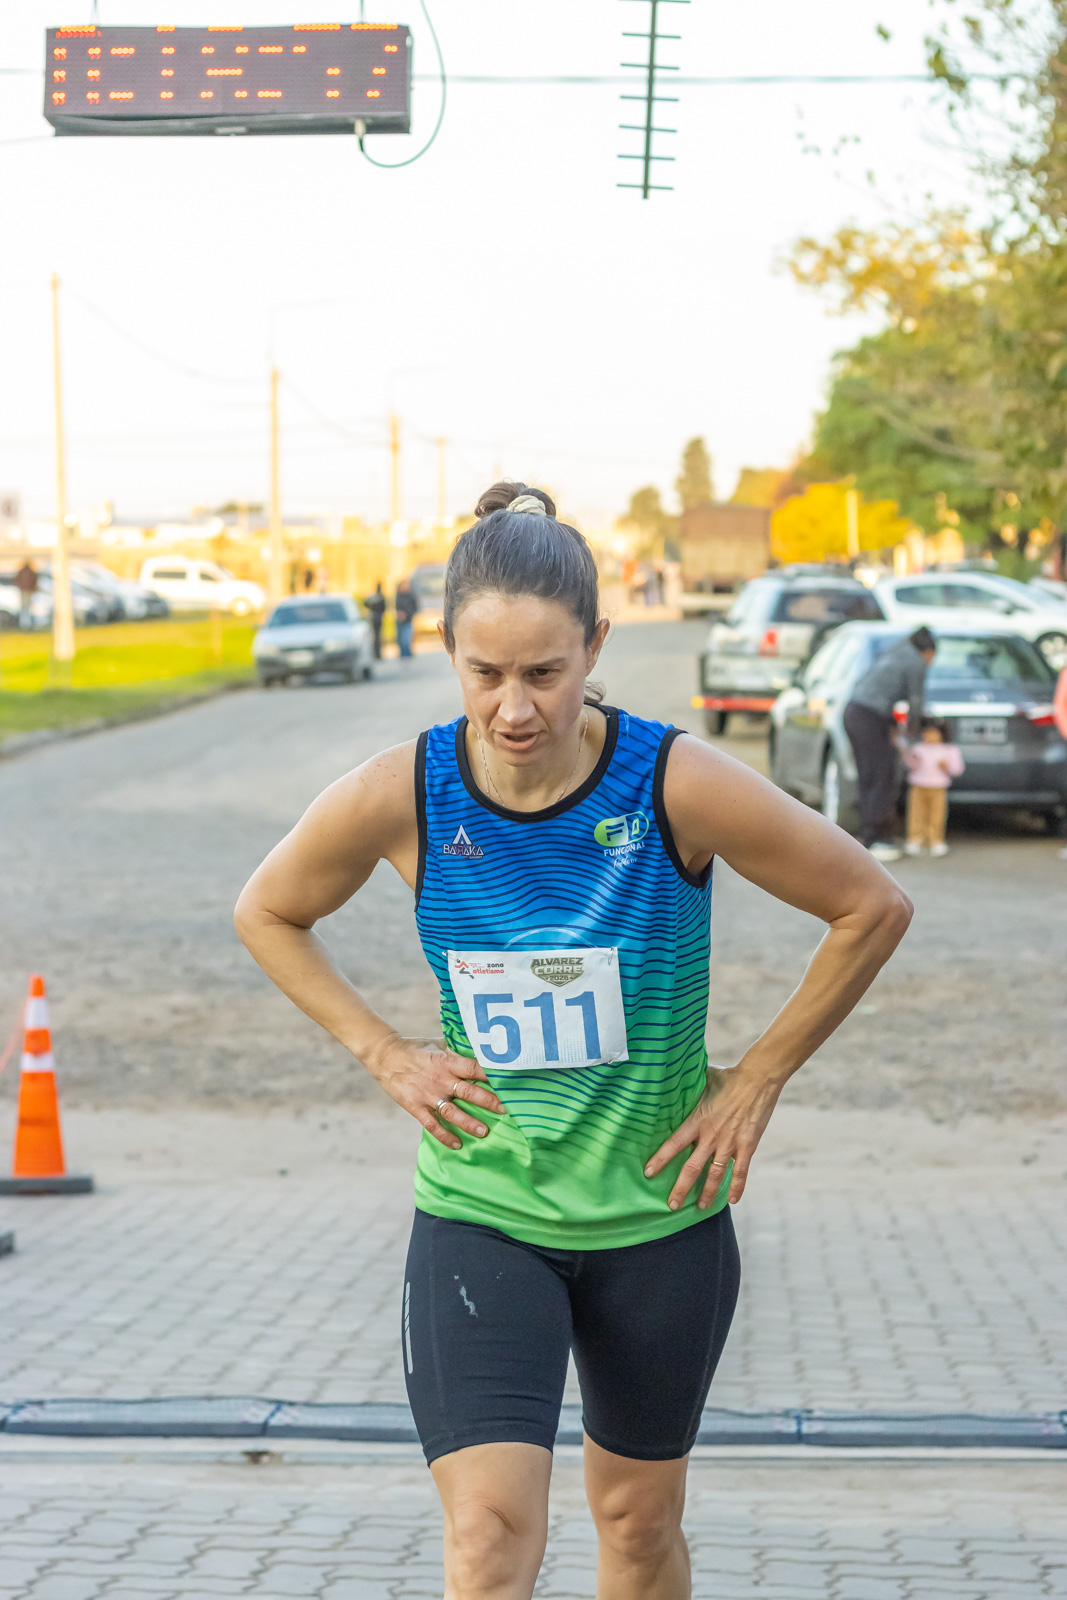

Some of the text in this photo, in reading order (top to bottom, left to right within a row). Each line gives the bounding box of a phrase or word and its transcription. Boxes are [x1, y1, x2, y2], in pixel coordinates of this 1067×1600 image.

[531, 957, 584, 967] ALVAREZ
[535, 965, 583, 975] CORRE
[473, 991, 601, 1063] 511
